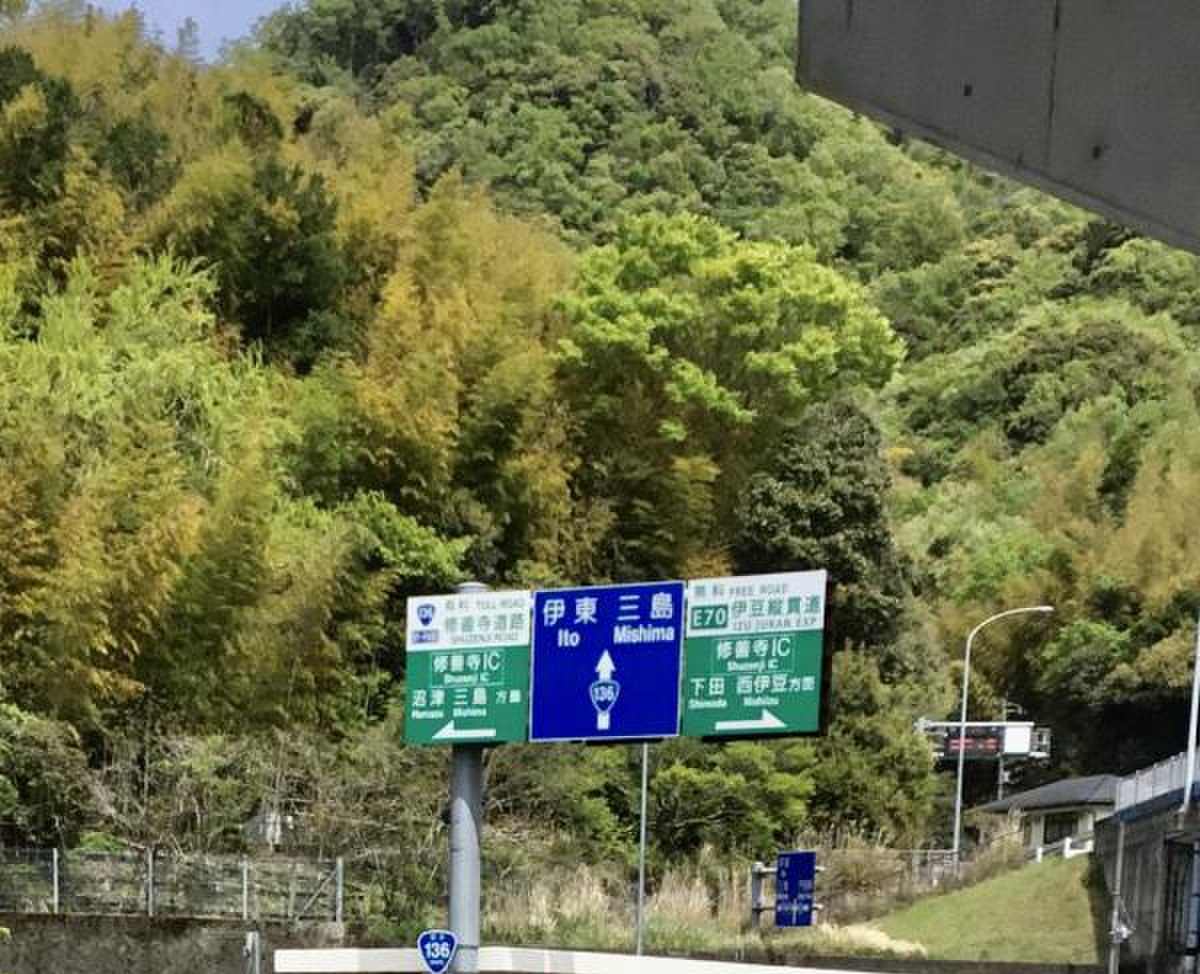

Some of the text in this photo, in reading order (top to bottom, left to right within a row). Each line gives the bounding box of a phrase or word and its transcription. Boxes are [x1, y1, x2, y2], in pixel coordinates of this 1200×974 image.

[543, 592, 673, 627] 伊東 三島
[692, 607, 726, 627] E70
[557, 624, 675, 648] Ito Mishima
[594, 685, 615, 702] 136
[690, 676, 725, 696] 下田
[423, 942, 450, 959] 136
